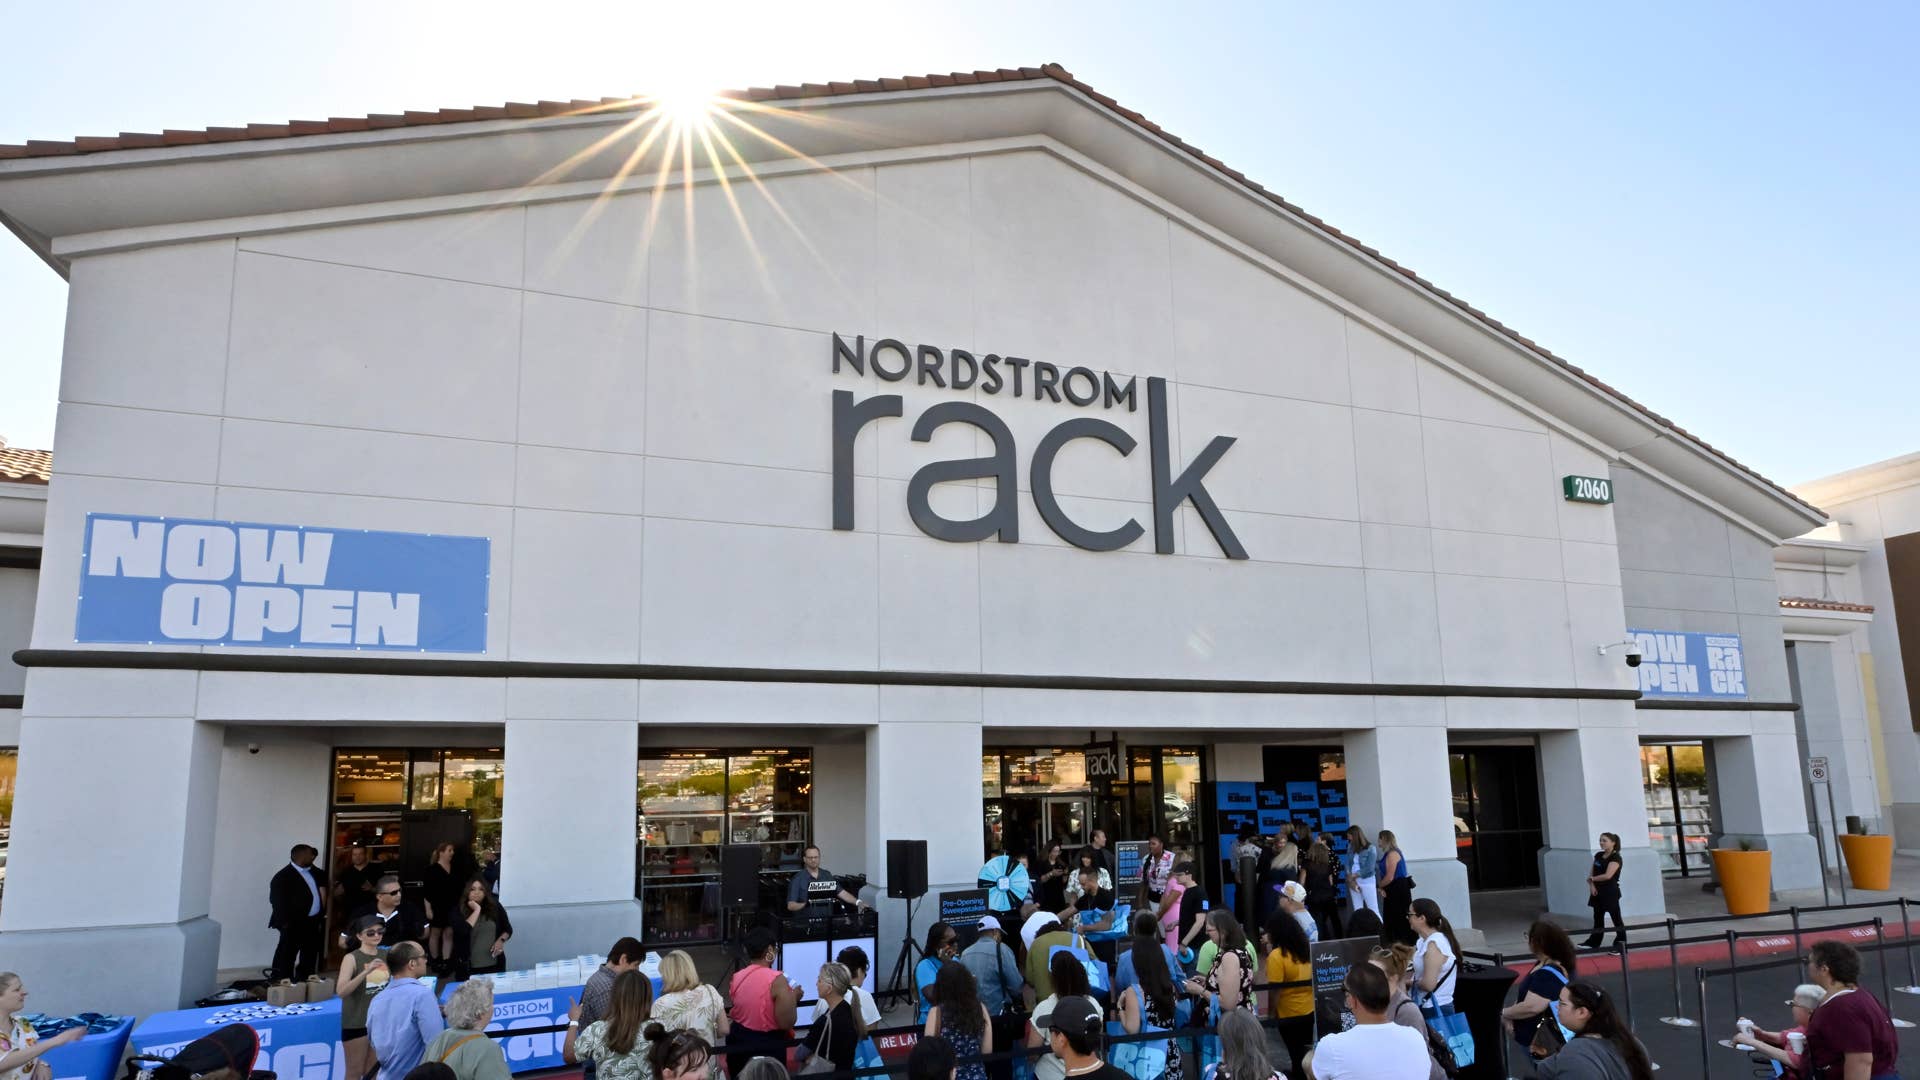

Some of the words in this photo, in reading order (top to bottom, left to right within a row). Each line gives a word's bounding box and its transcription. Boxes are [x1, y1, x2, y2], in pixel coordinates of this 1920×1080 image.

[832, 331, 1137, 412] NORDSTROM
[832, 376, 1250, 560] rack
[1575, 478, 1609, 500] 2060
[88, 518, 334, 586] NOW
[159, 582, 421, 646] OPEN
[1636, 661, 1699, 692] PEN
[1086, 747, 1118, 775] rack
[943, 898, 984, 909] Pre-Opening
[943, 905, 986, 915] Sweepstakes
[1316, 967, 1328, 976] Hey
[1318, 975, 1331, 983] Your
[494, 1001, 549, 1018] DSTROM
